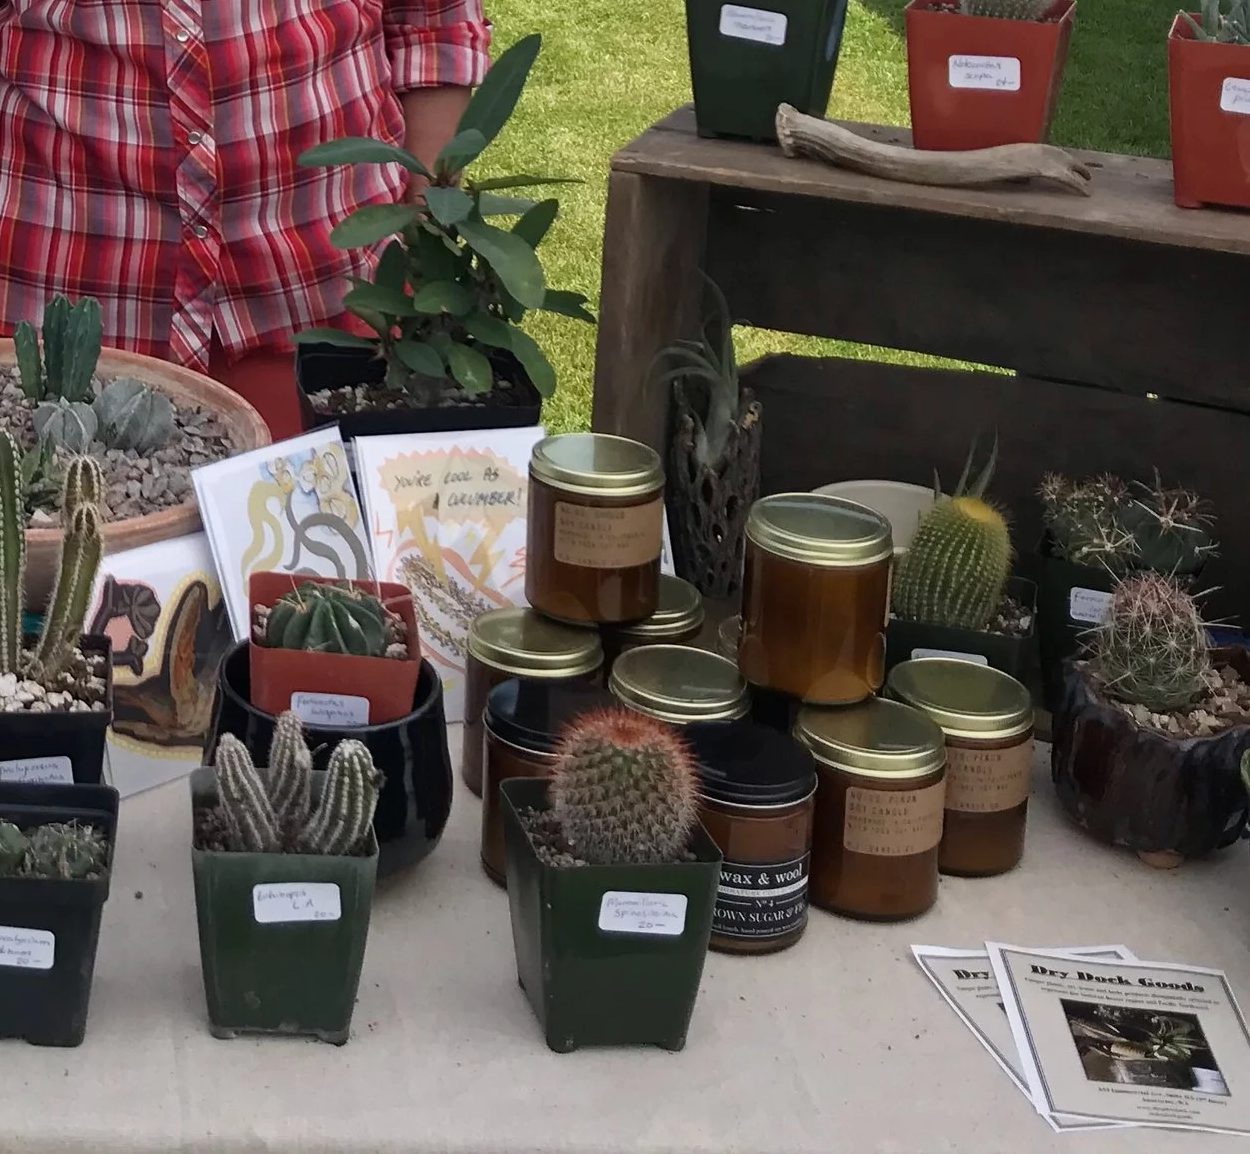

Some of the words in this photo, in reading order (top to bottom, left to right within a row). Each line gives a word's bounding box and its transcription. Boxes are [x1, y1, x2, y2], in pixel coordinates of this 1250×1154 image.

[483, 466, 500, 482] AS
[447, 487, 522, 507] CUCUMBER!
[719, 870, 753, 885] wax
[758, 872, 770, 885] &
[775, 862, 803, 884] wool
[713, 907, 746, 923] ROWN
[749, 910, 785, 923] SUGAR
[953, 969, 990, 980] Dry
[1030, 964, 1069, 979] Dry
[1077, 971, 1133, 986] Dock
[1138, 977, 1205, 993] Goods
